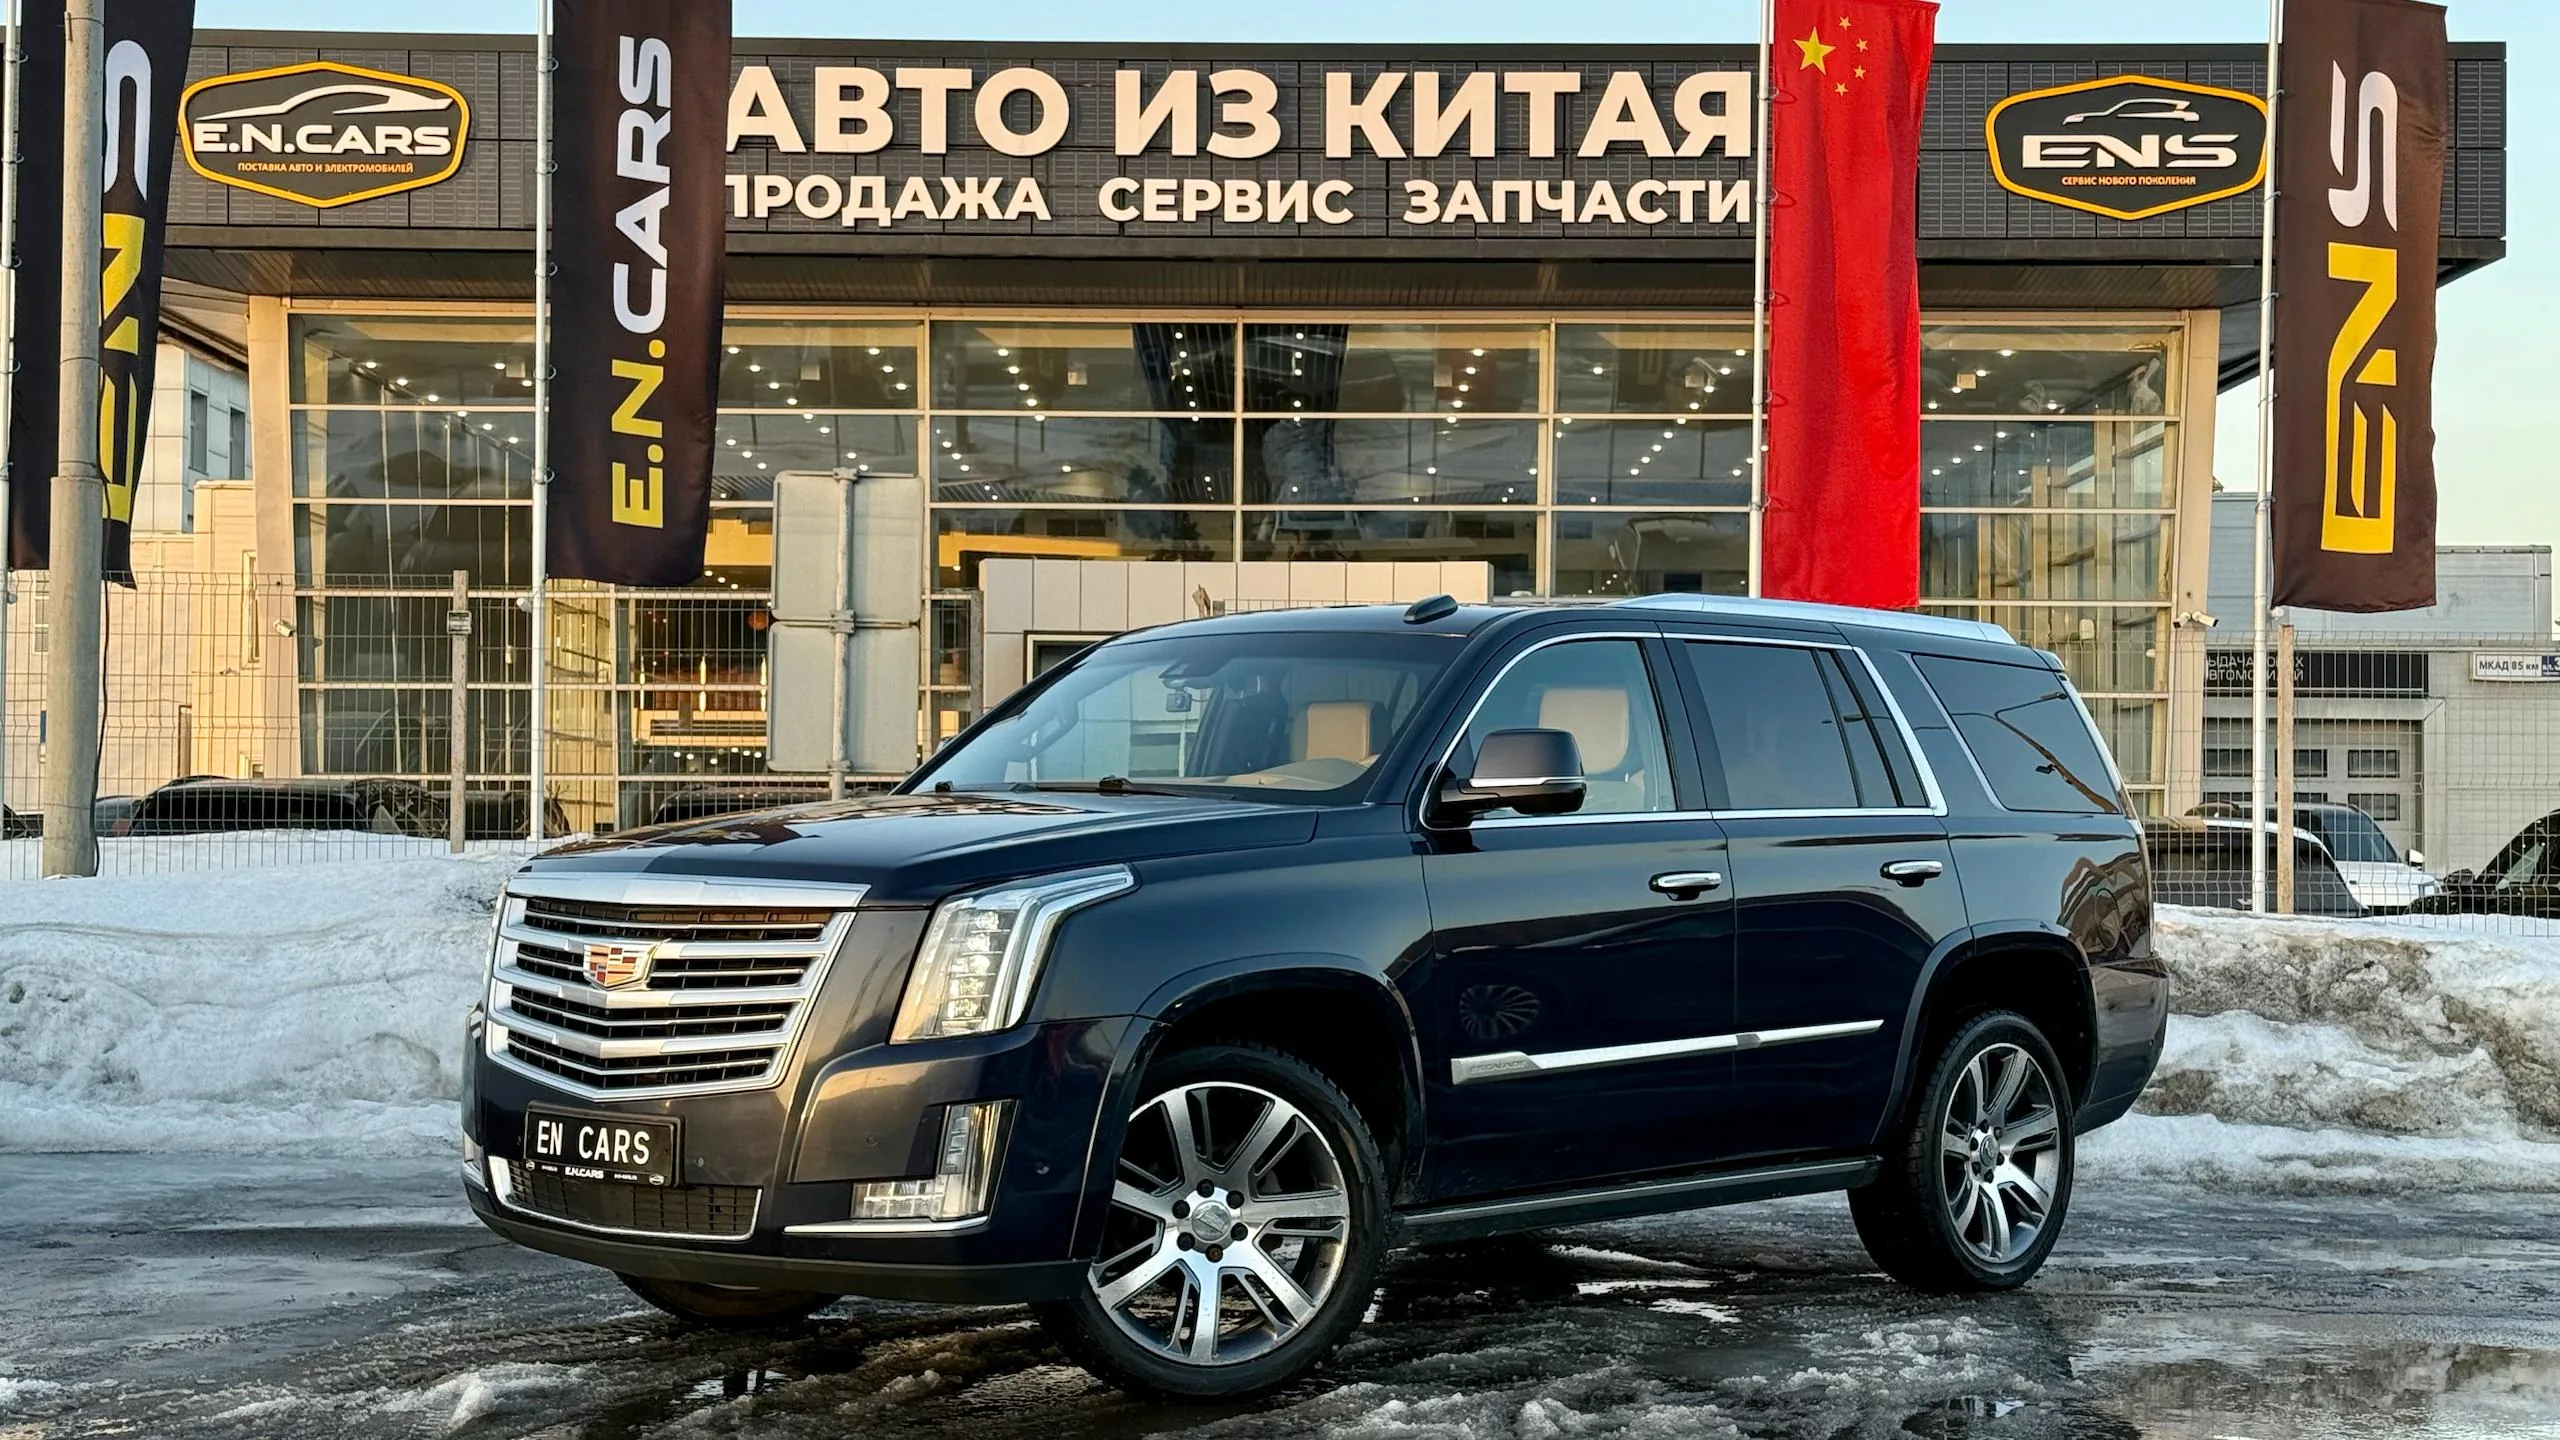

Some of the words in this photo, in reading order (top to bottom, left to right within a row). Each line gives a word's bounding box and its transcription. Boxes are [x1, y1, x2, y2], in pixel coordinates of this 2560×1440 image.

[726, 65, 1070, 157] АВТО
[1115, 69, 1282, 159] ИЗ
[1325, 71, 1751, 159] КИТАЯ
[193, 123, 452, 156] E.N.CARS
[2022, 134, 2239, 168] ENS
[238, 162, 287, 172] ПОСТАВКА
[289, 163, 313, 172] АВТО
[315, 163, 323, 172] И
[324, 162, 414, 173] ЭЛЕКТРОМОБИЛЕЙ
[2061, 176, 2098, 186] СЕРВИС
[2099, 176, 2137, 186] НОВОГО
[2138, 176, 2197, 186] ПОКОЛЕНИЯ
[1098, 177, 1354, 224] СЕРВИС
[1403, 178, 1750, 225] ЗАПЧАСТИ
[612, 35, 672, 528] E.N.CARS
[2321, 60, 2397, 554] ENS
[2208, 656, 2254, 668] ЫДАЧА
[2479, 660, 2509, 672] МКАД
[2525, 663, 2539, 671] км
[537, 1120, 563, 1156] EN
[578, 1126, 650, 1165] CARS
